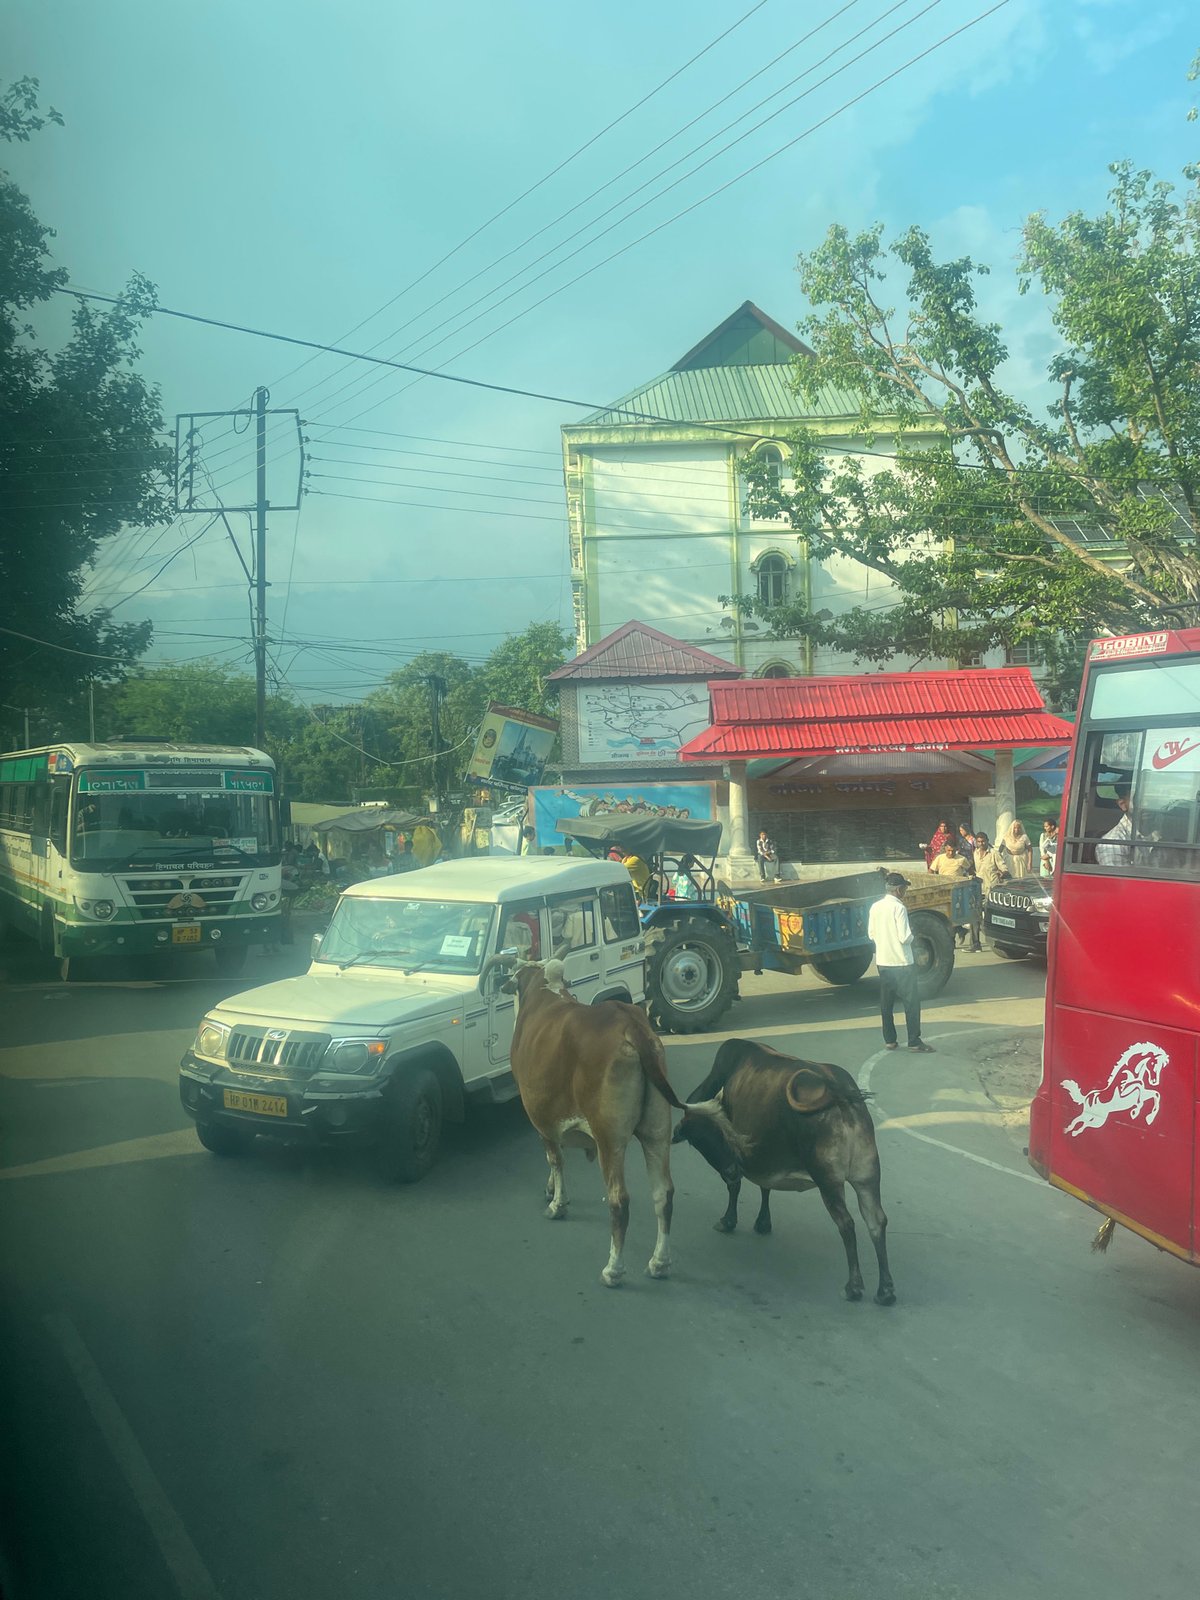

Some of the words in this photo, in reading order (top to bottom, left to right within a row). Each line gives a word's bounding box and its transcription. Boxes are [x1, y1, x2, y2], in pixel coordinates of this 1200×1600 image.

[1103, 634, 1167, 650] GOBIND
[155, 862, 185, 870] हिमाचल
[187, 861, 215, 869] परिवहन
[230, 1094, 241, 1106] HP
[262, 1100, 285, 1113] 2414
